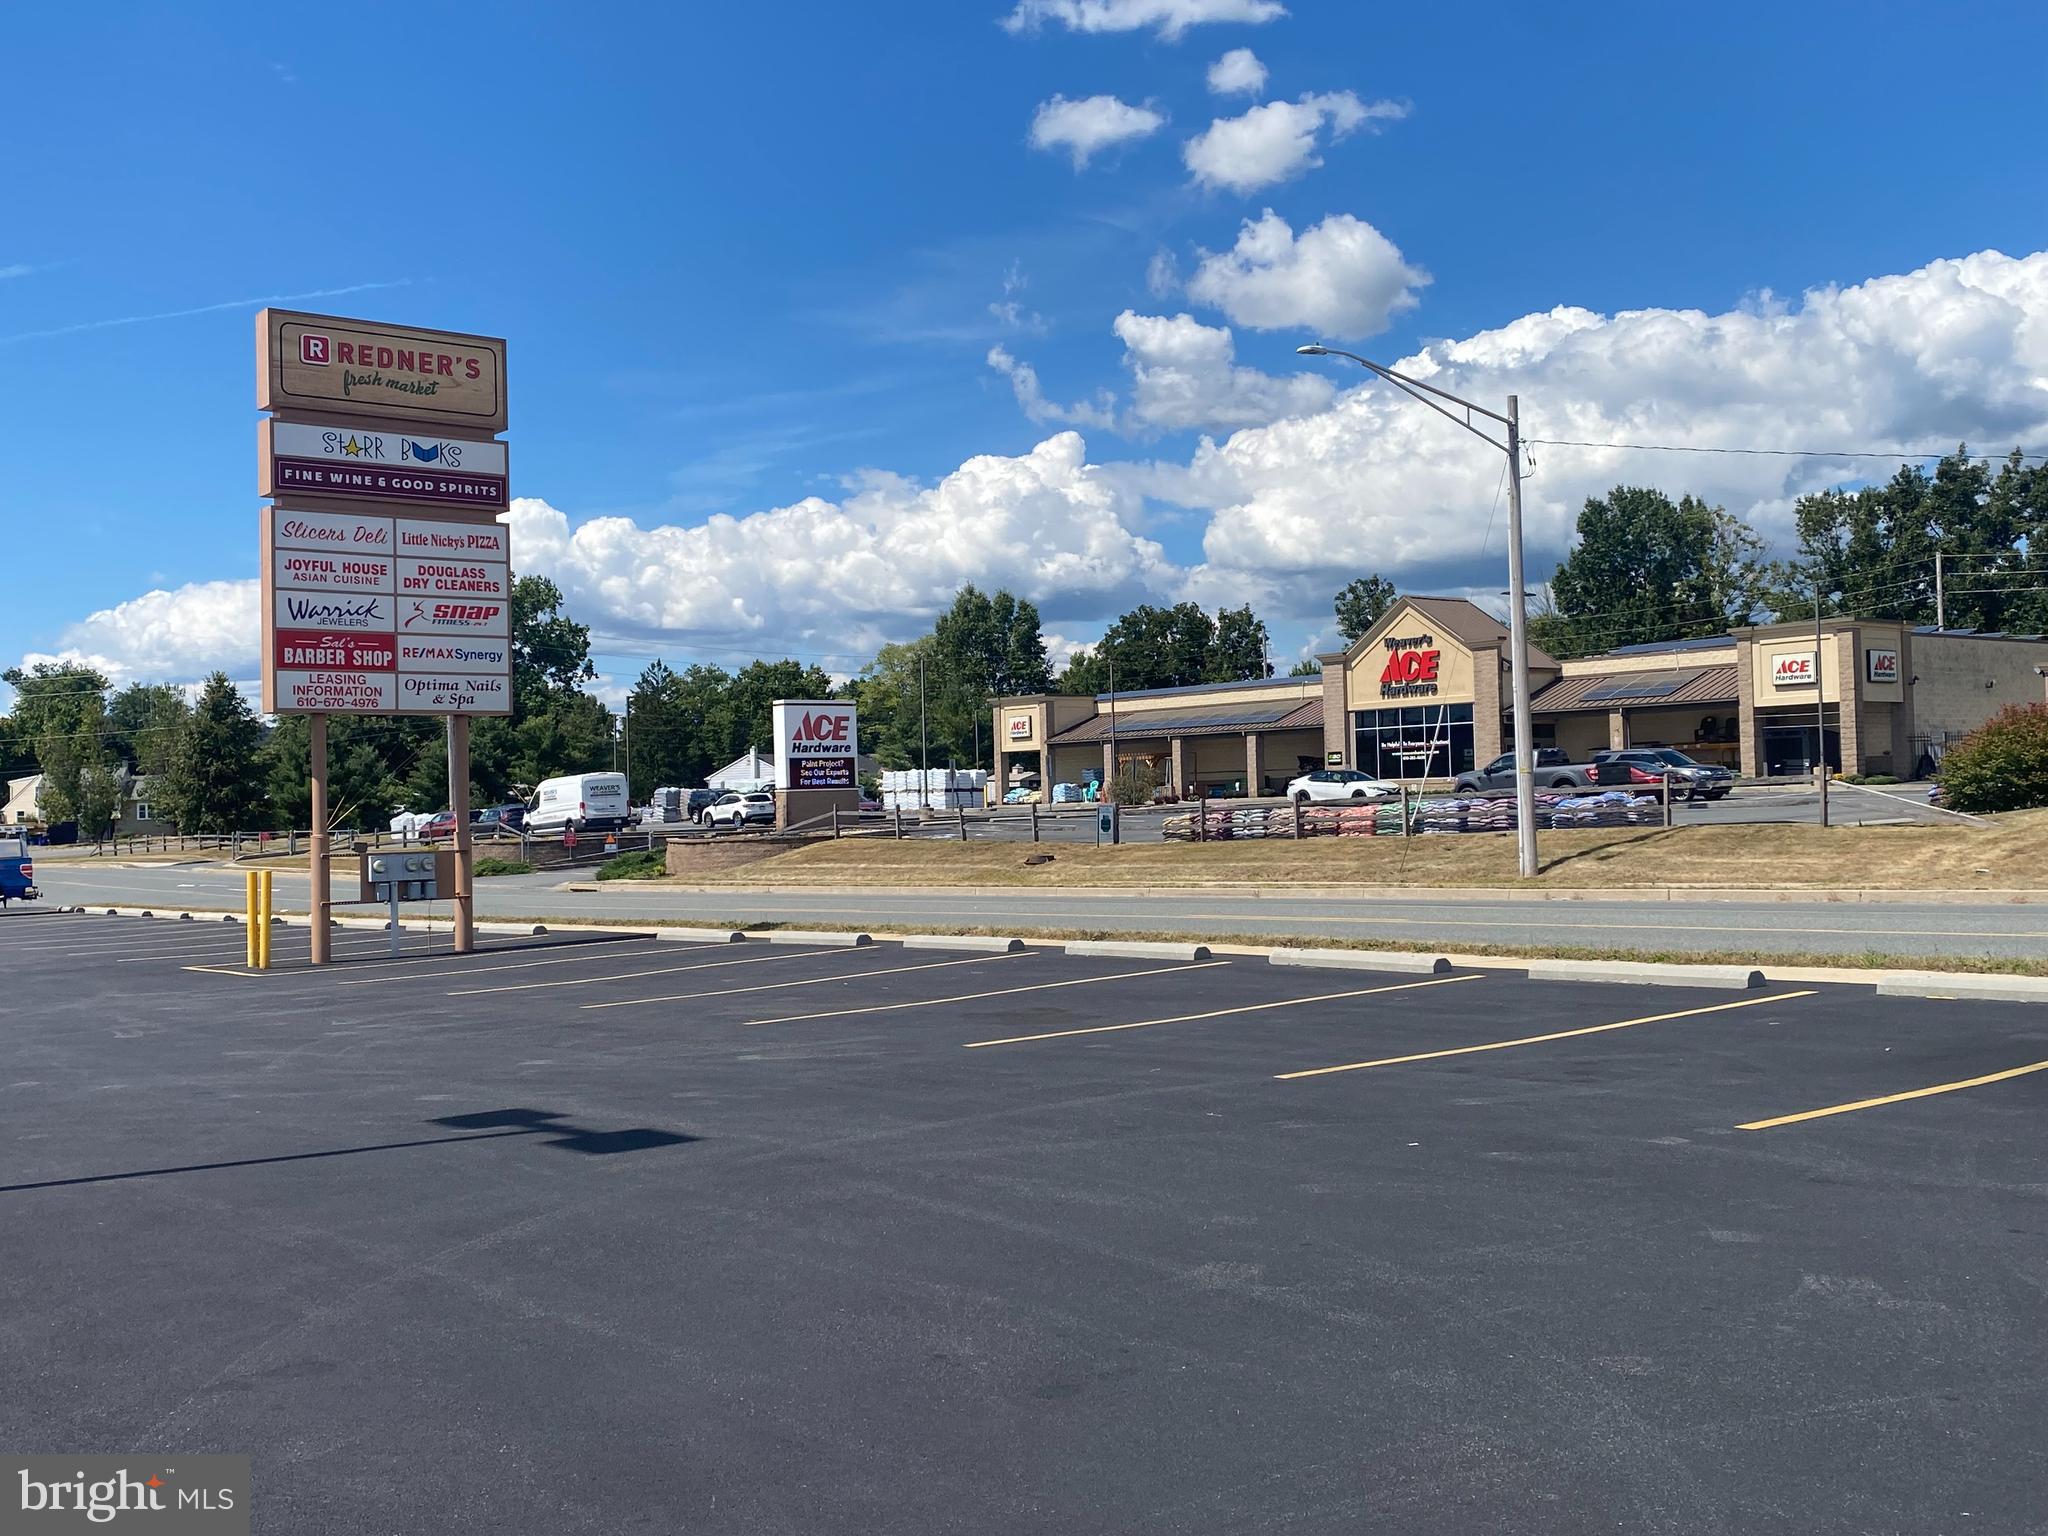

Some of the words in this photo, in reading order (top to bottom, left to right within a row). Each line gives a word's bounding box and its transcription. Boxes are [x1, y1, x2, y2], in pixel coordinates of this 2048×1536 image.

[338, 342, 480, 379] REDNER'S
[344, 370, 382, 396] fresh
[386, 377, 440, 395] market
[285, 469, 323, 482] FINE
[330, 473, 373, 486] WINE
[378, 477, 386, 487] &
[391, 478, 434, 491] GOOD
[439, 482, 497, 496] SPIRITS
[281, 521, 346, 541] Slicers
[353, 526, 388, 544] Deli
[402, 532, 428, 546] Little
[431, 534, 465, 551] Nicky's
[467, 535, 500, 550] PIZZA
[284, 559, 336, 573] JOYFUL
[342, 562, 387, 576] HOUSE
[418, 565, 486, 579] DOUGLASS
[293, 573, 327, 583] ASIAN
[333, 575, 380, 586] CUISINE
[403, 577, 429, 589] DRY
[435, 579, 500, 593] CLEANERS
[287, 597, 385, 621] Warrick
[317, 617, 369, 627] JEWELERS
[320, 636, 355, 648] Sal's
[1384, 634, 1433, 650] Weaver's
[284, 648, 345, 665] BARBER
[353, 650, 392, 666] SHOP
[454, 648, 503, 662] Synergy
[1874, 654, 1896, 671] ACE
[1379, 647, 1440, 683] ACE
[1776, 659, 1811, 674] ACE
[309, 673, 367, 685] LEASING
[293, 685, 382, 697] INFORMATION
[405, 679, 460, 695] Optima
[465, 679, 502, 692] Nails
[1380, 683, 1439, 698] Hardware
[296, 697, 379, 708] 610-670-4976
[432, 694, 446, 704] &
[449, 692, 476, 709] Spa
[792, 710, 850, 741] ACE
[1011, 721, 1027, 730] ACE
[792, 742, 852, 753] Hardware
[802, 760, 818, 768] Paint
[819, 760, 844, 769] Project?
[826, 769, 849, 777] Experts
[590, 784, 621, 792] WEAVER'S
